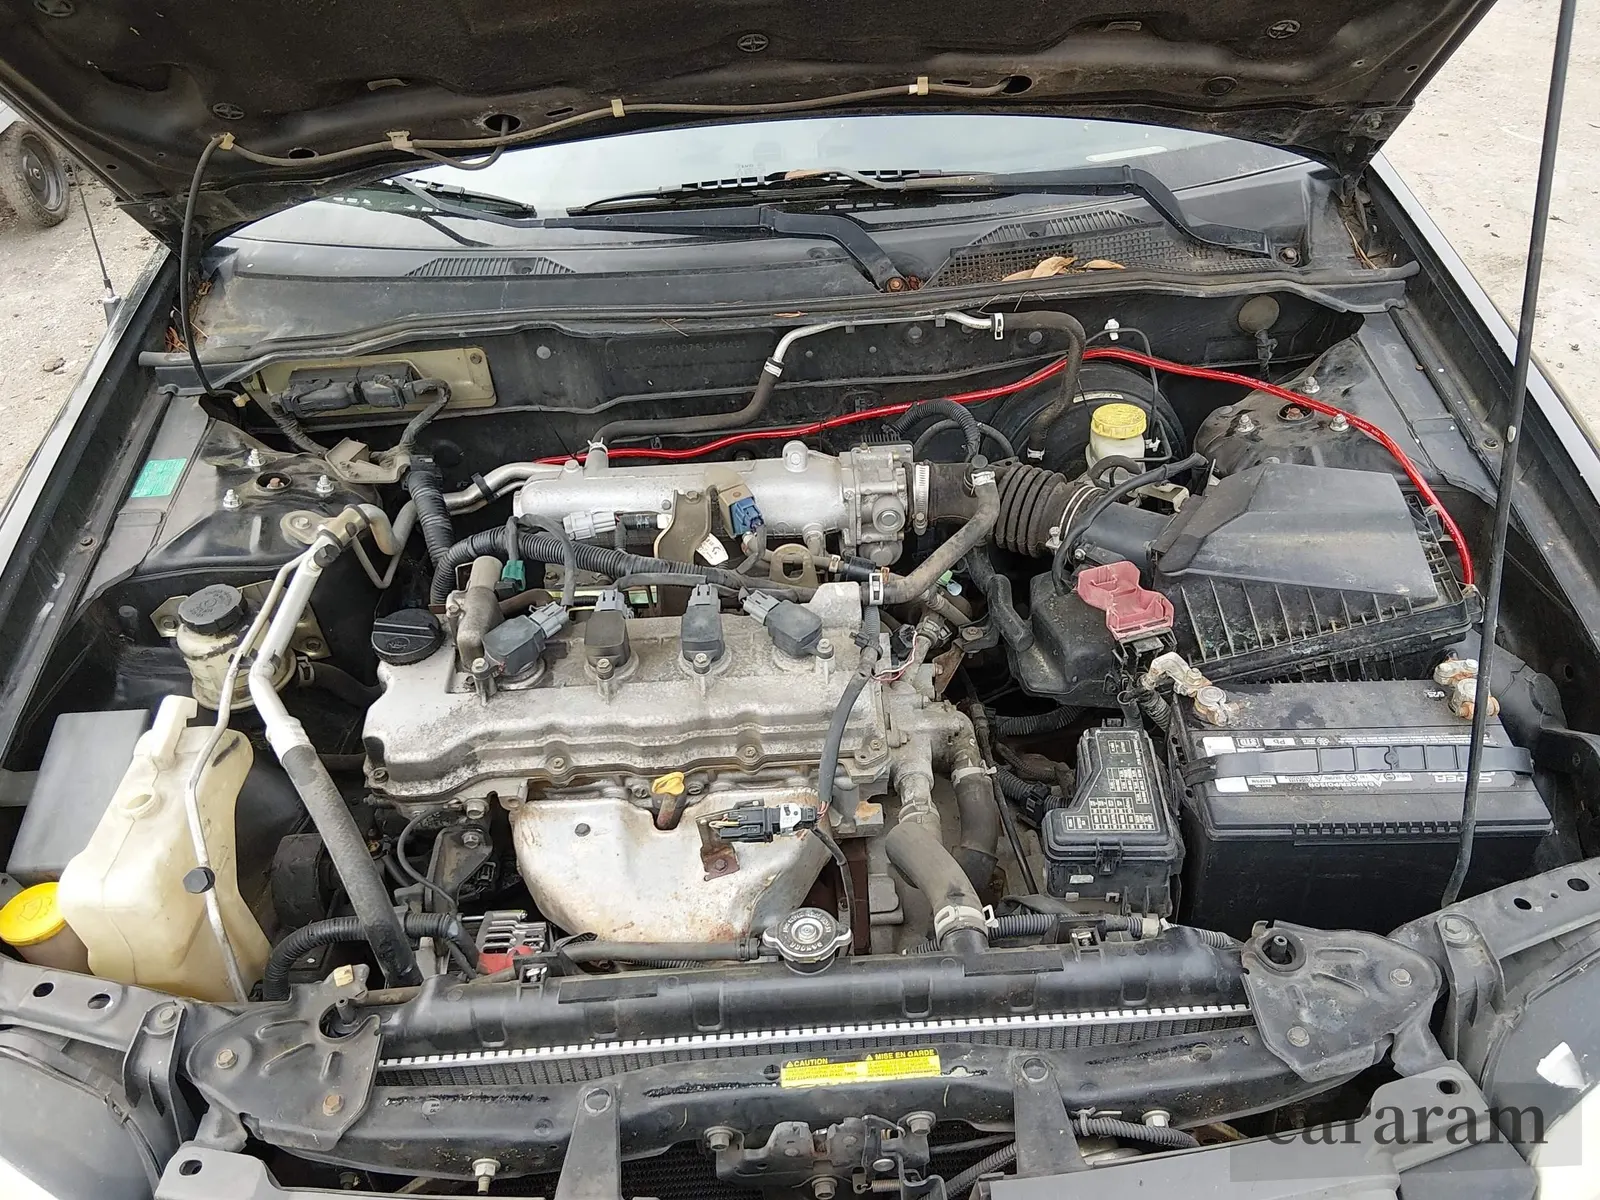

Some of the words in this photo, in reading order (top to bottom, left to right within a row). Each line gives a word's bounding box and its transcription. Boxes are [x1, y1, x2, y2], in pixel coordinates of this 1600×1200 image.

[1434, 774, 1492, 783] SPER
[874, 1052, 894, 1060] MISE
[895, 1051, 906, 1059] EN
[907, 1049, 935, 1058] GARDE
[793, 1057, 829, 1068] CAUTION
